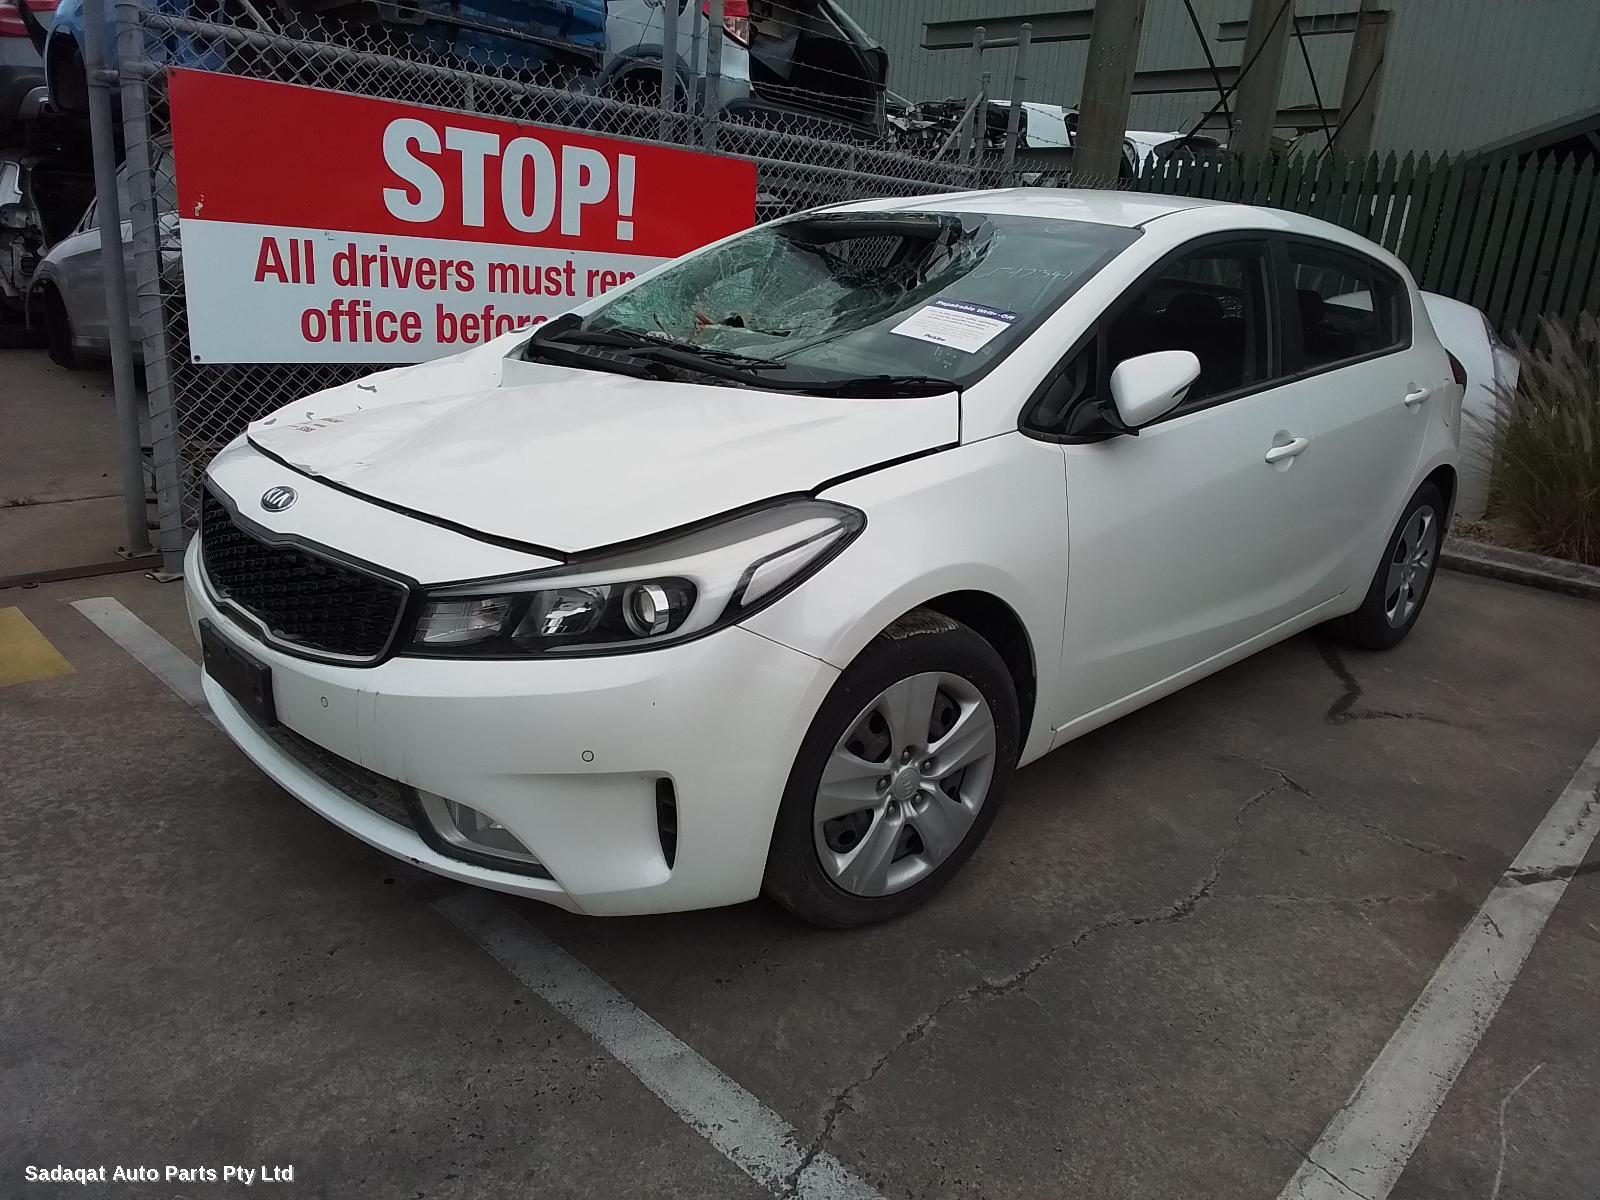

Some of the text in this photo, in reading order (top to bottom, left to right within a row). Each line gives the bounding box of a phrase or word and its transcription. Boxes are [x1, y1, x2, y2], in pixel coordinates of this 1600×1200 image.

[382, 118, 636, 241] STOP!
[255, 236, 315, 285] All
[332, 243, 476, 293] drivers
[488, 263, 576, 298] must
[301, 299, 547, 345] office befor
[935, 300, 975, 312] Repairable
